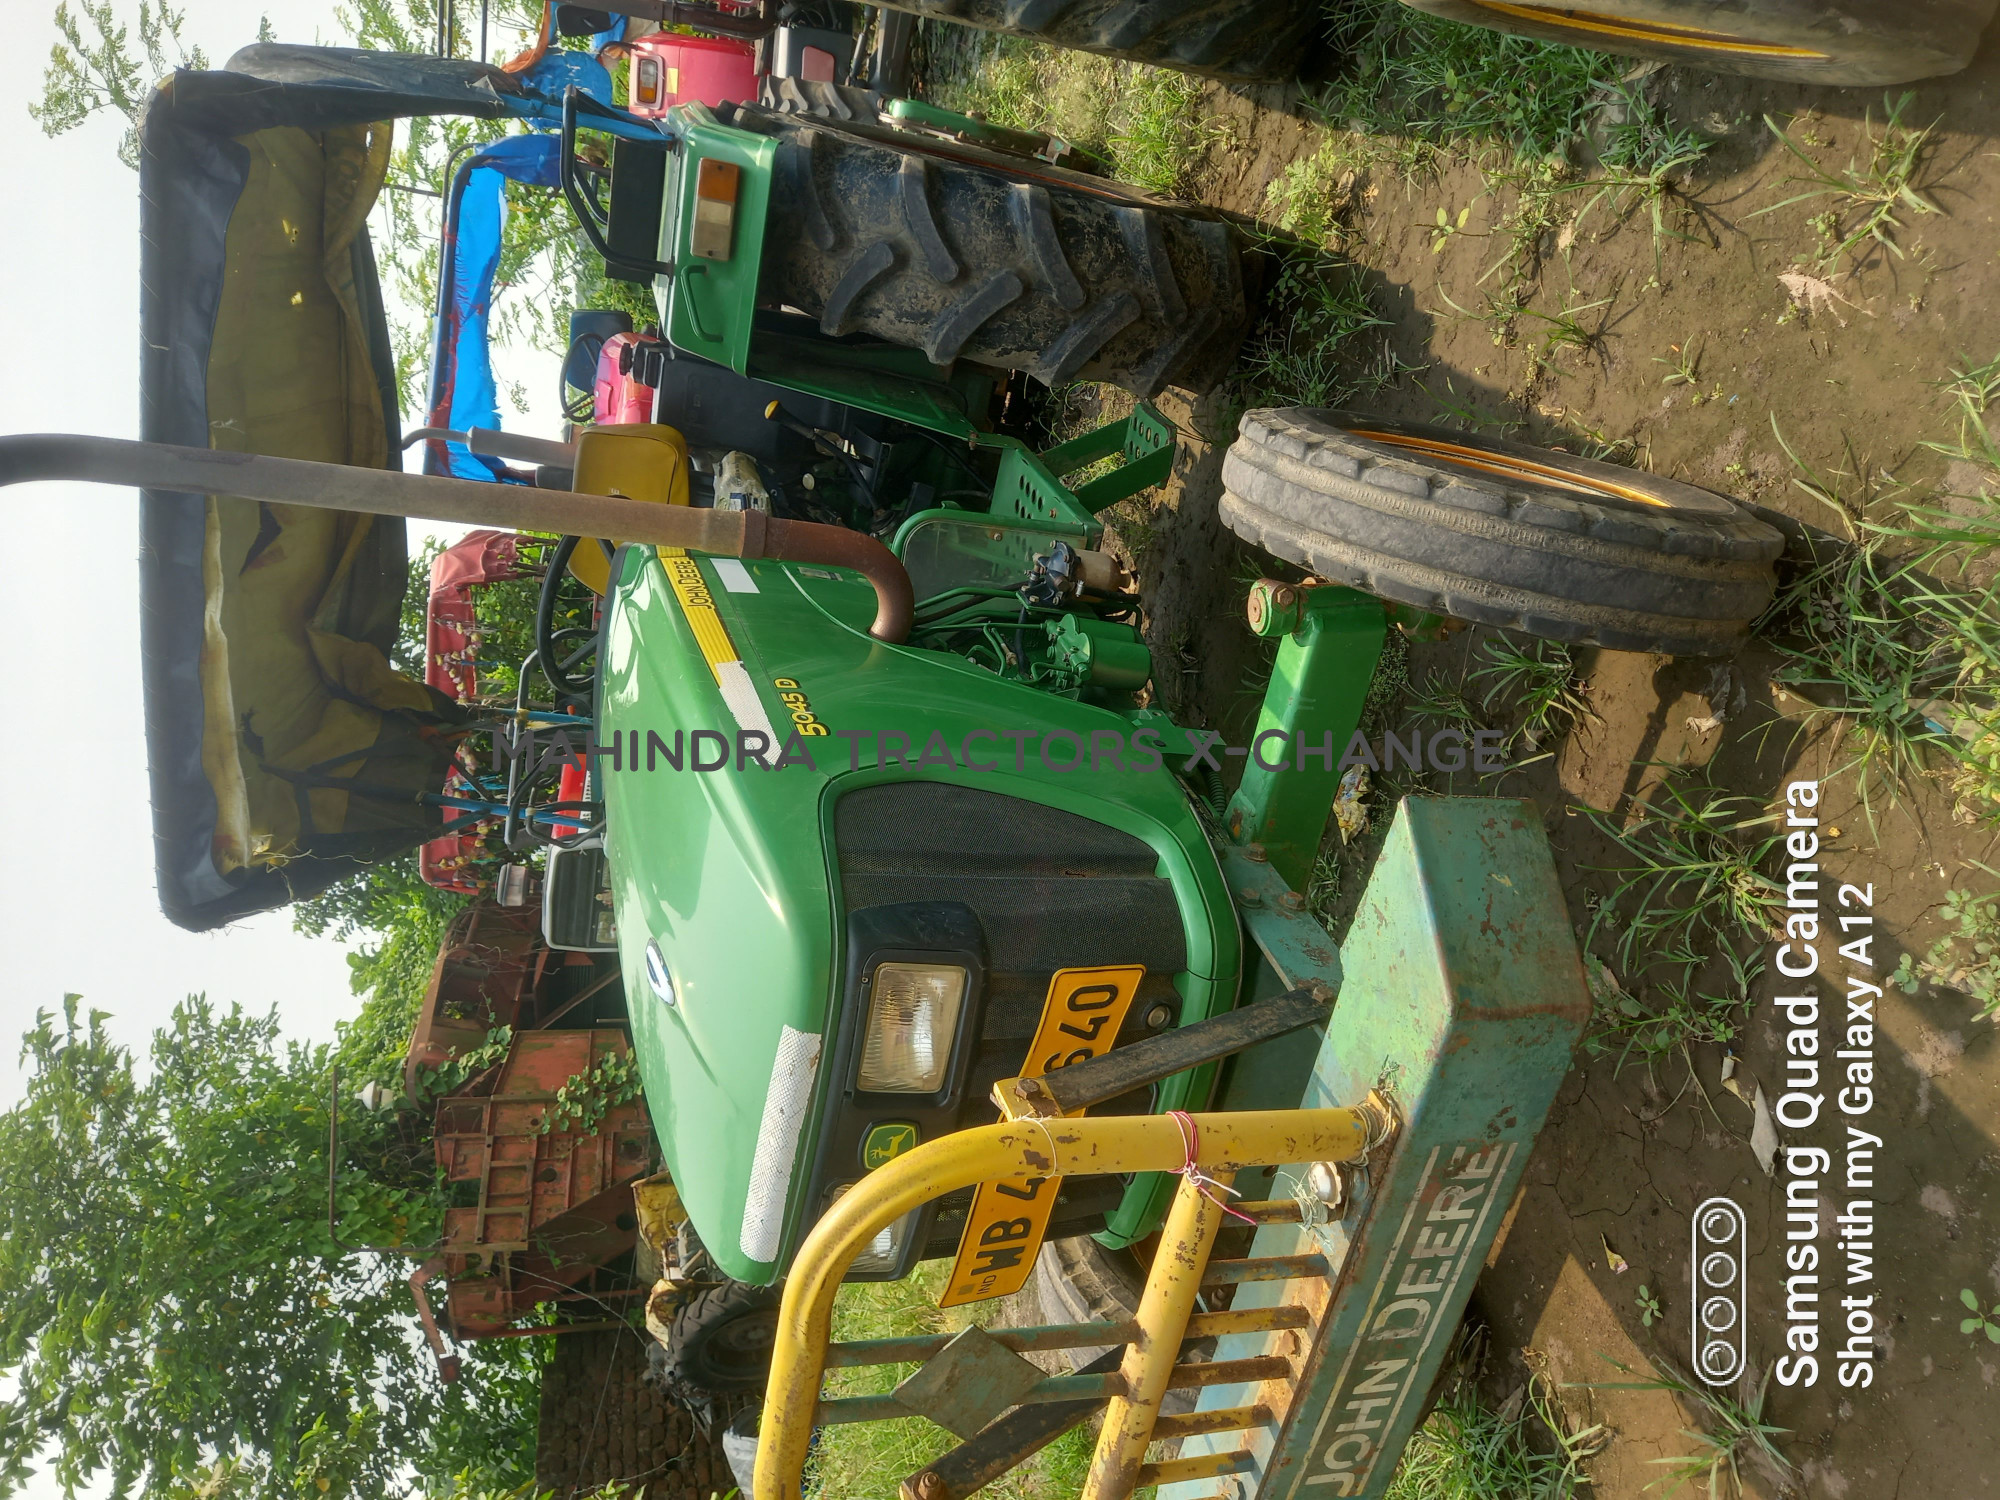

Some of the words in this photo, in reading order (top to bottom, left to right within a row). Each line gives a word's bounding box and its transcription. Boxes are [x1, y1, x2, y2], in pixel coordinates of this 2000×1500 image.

[672, 560, 702, 584] DEERE
[683, 585, 712, 610] JOHN
[773, 678, 799, 689] D
[780, 692, 830, 736] 5045
[970, 1217, 1032, 1276] WB
[977, 1274, 998, 1295] IND
[1304, 1358, 1409, 1497] JOHN
[1367, 1142, 1503, 1341] DEERE
